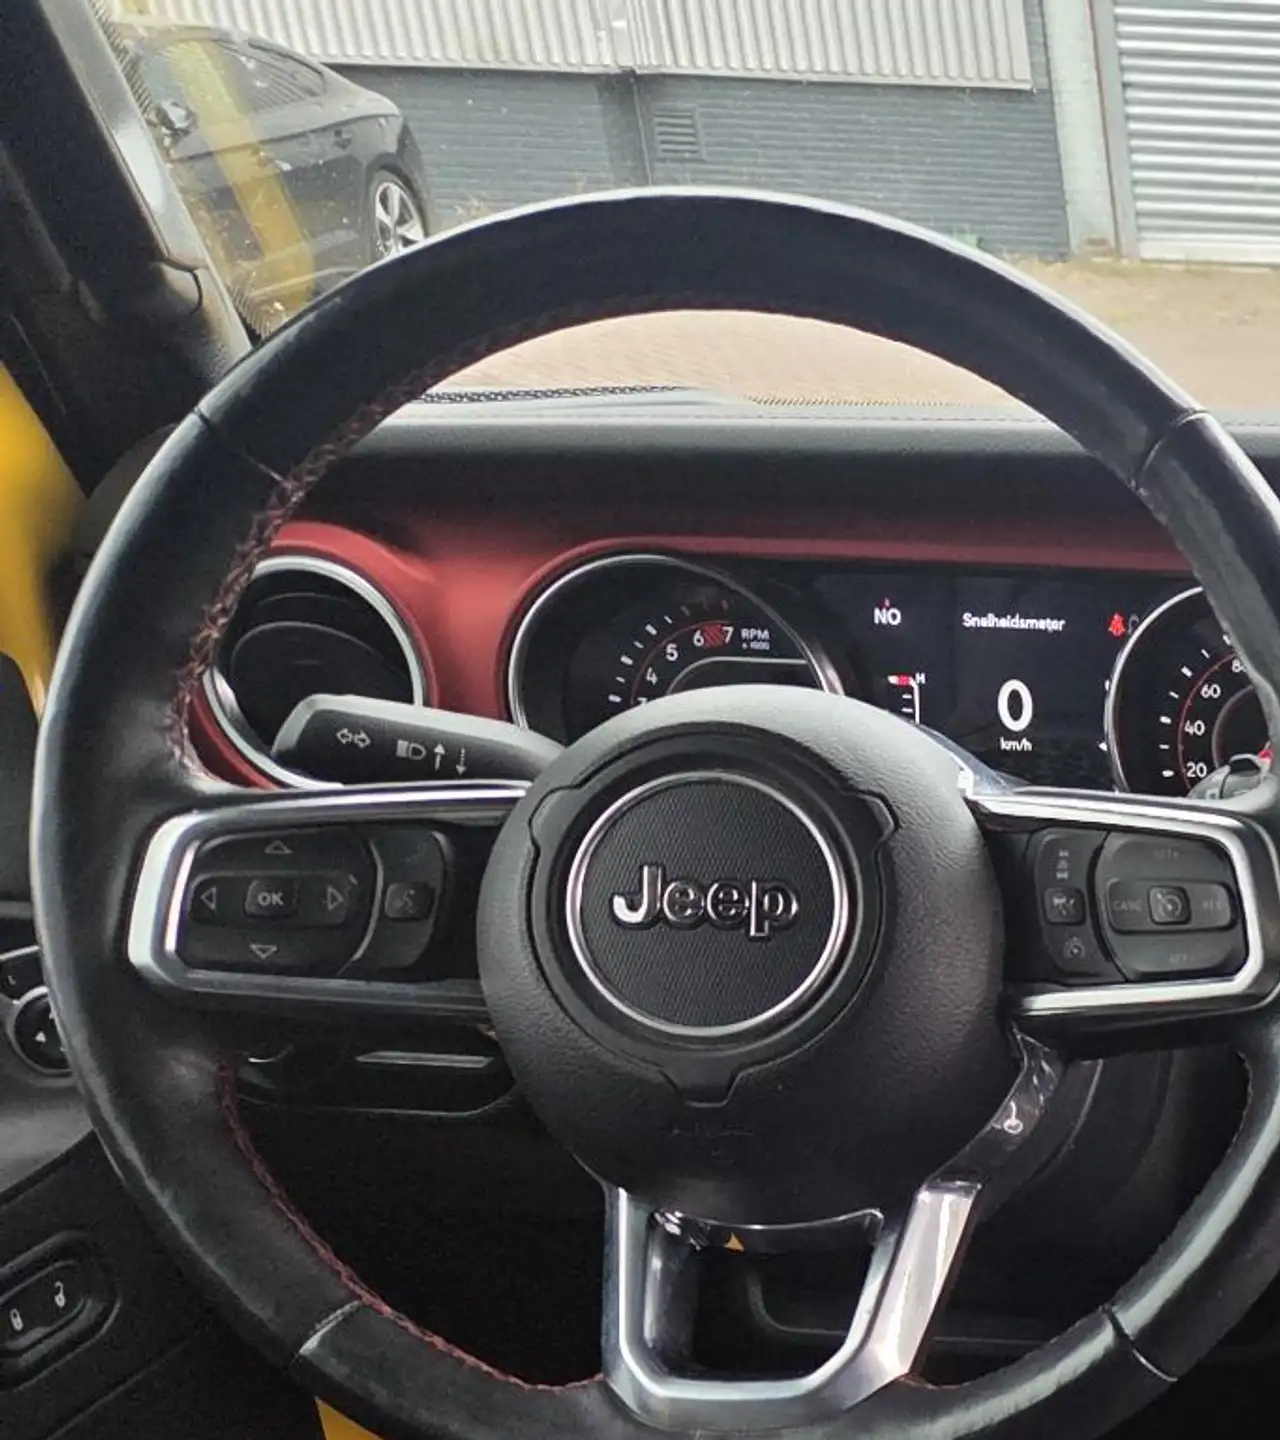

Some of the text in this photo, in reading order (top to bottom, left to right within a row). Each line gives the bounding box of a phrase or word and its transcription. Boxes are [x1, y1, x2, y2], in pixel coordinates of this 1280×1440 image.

[873, 608, 901, 625] NO
[962, 612, 1066, 632] Snelheidsmeter
[693, 630, 704, 647] 6
[722, 626, 734, 644] 7
[740, 627, 770, 640] RPM
[666, 643, 678, 661] 5
[646, 668, 658, 684] 4
[915, 673, 925, 684] H
[1200, 684, 1221, 699] 60
[998, 679, 1033, 732] 0
[1184, 719, 1205, 736] 40
[1000, 738, 1032, 751] km/h
[1186, 762, 1207, 778] 20
[257, 891, 285, 907] OK
[613, 864, 800, 937] Jeep
